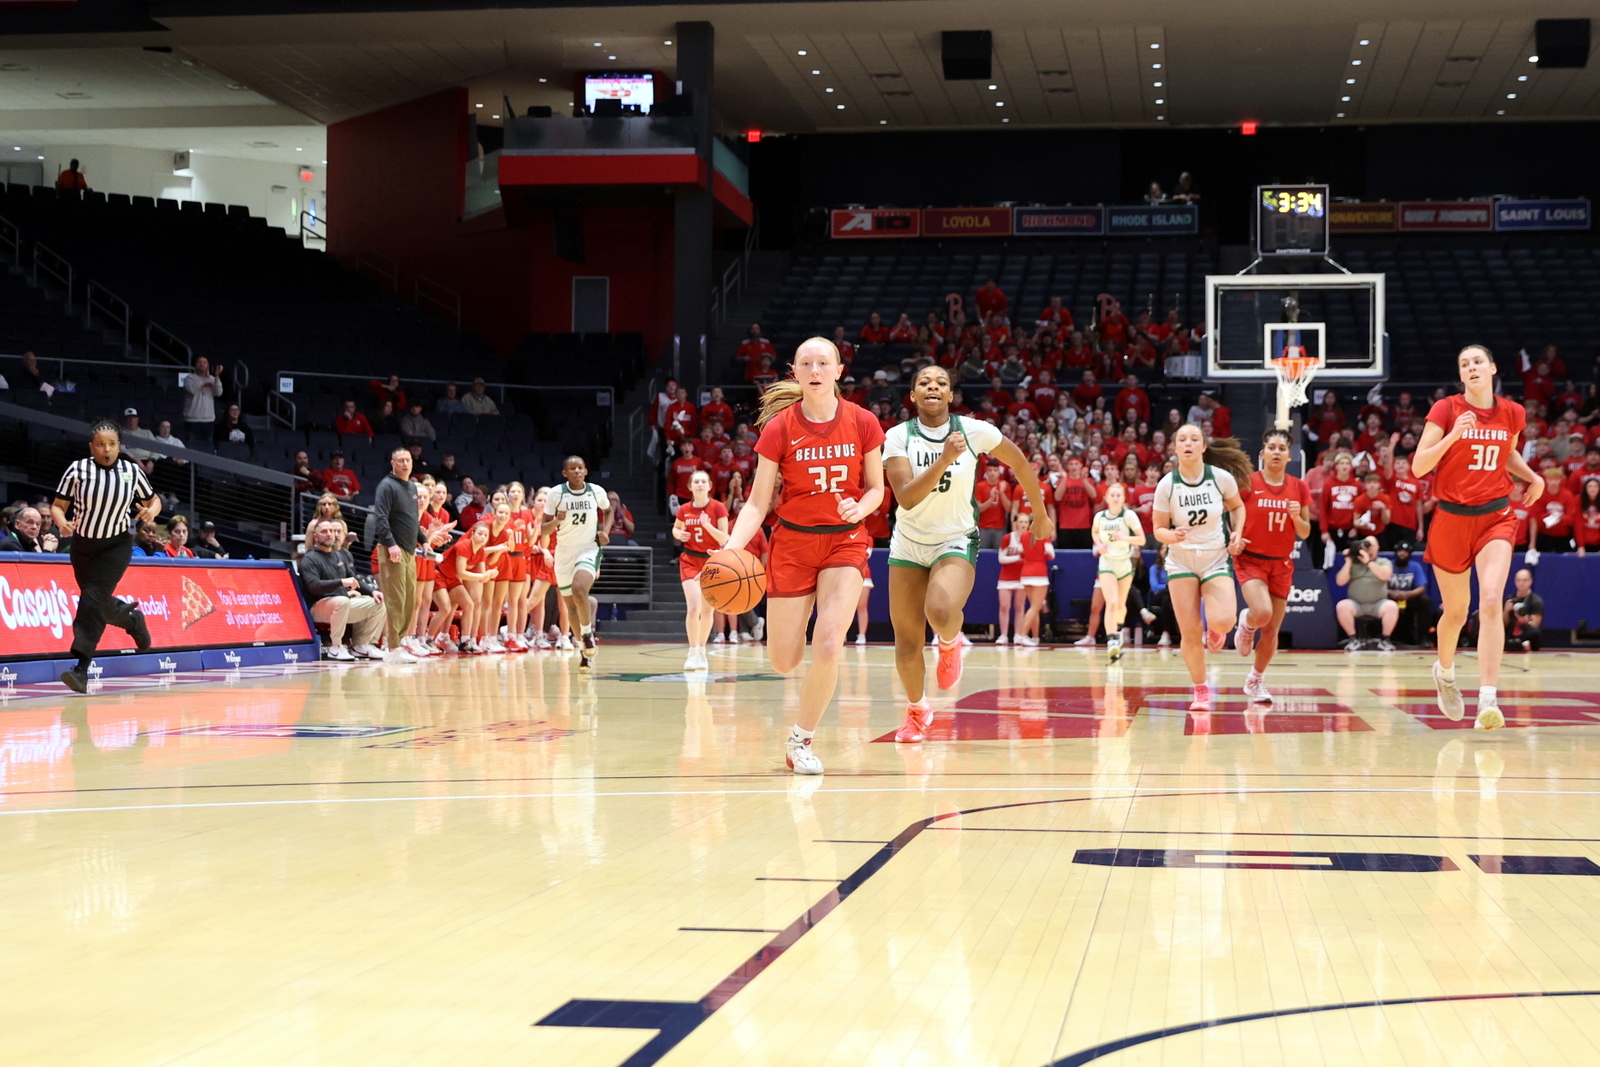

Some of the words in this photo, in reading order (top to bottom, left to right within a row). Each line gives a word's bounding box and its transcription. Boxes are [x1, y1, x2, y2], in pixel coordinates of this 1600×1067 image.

[1278, 192, 1321, 213] 3:34
[1111, 215, 1148, 226] RHODE
[1152, 213, 1192, 226] ISLAND
[1500, 208, 1541, 221] SAINT
[1545, 207, 1586, 220] LOUIS
[943, 216, 990, 228] LOYOLA
[1461, 428, 1508, 441] BELLEVUE
[795, 443, 856, 461] BELLEVUE
[1468, 444, 1501, 471] 30
[808, 464, 848, 495] 32
[931, 471, 952, 493] 5
[566, 500, 592, 511] LAUREL
[1179, 492, 1213, 507] LAUREL
[1257, 498, 1287, 509] BELLEV
[572, 512, 587, 525] 24
[1188, 508, 1208, 527] 22
[1268, 511, 1288, 532] 14
[694, 527, 704, 542] 2
[0, 575, 74, 639] Casey's
[138, 595, 171, 621] today!
[225, 610, 236, 625] all
